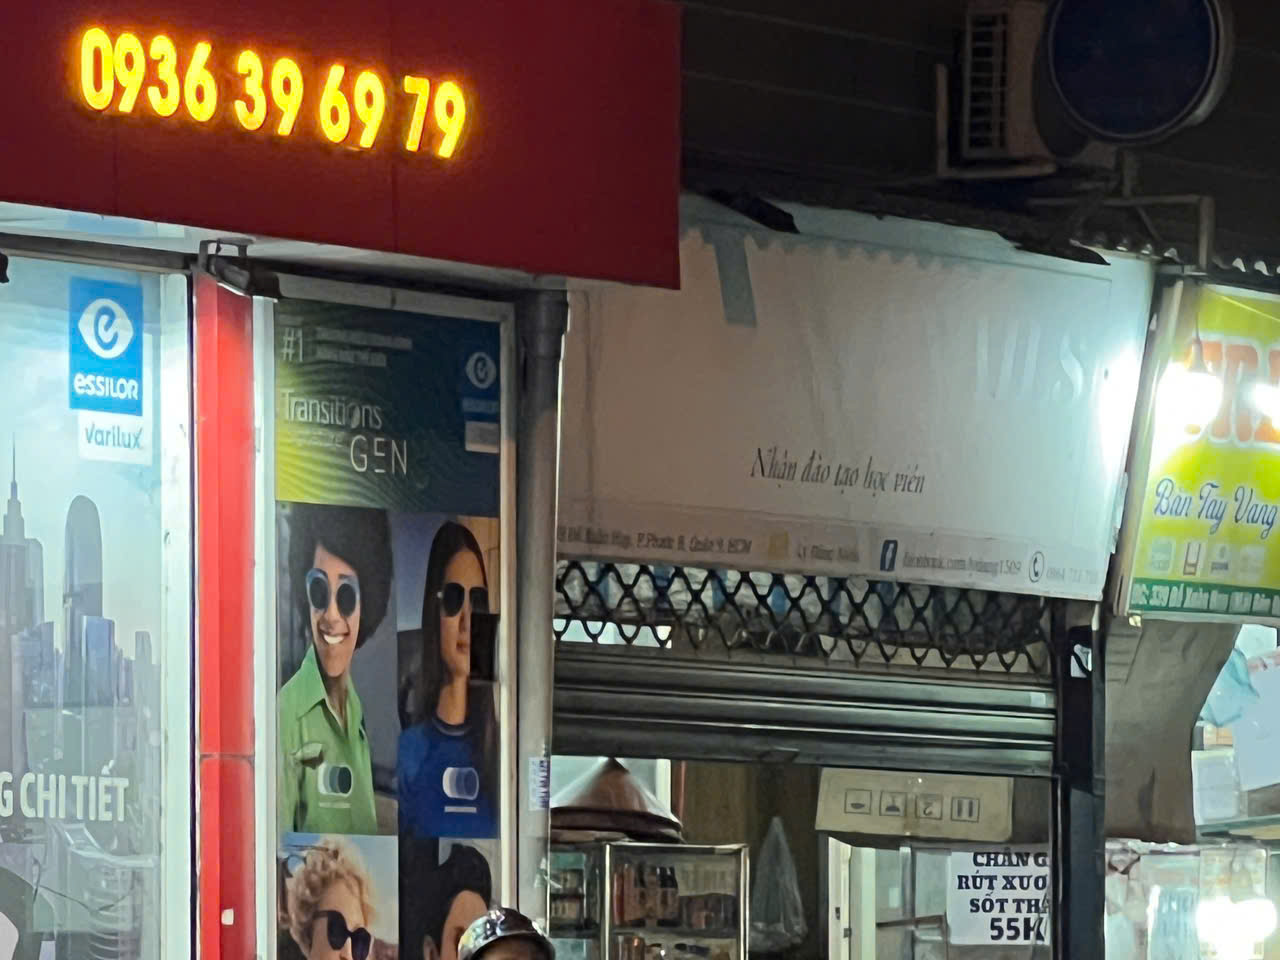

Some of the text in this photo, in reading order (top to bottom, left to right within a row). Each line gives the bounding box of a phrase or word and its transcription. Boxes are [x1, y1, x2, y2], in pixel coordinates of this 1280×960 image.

[81, 27, 466, 159] 0936 39 69 79
[20, 772, 66, 819] CHI
[71, 759, 129, 822] TIẾT
[1033, 852, 1049, 868] G
[957, 869, 998, 891] RÚT
[969, 891, 1009, 914] SỐT
[990, 917, 1046, 942] 55K
